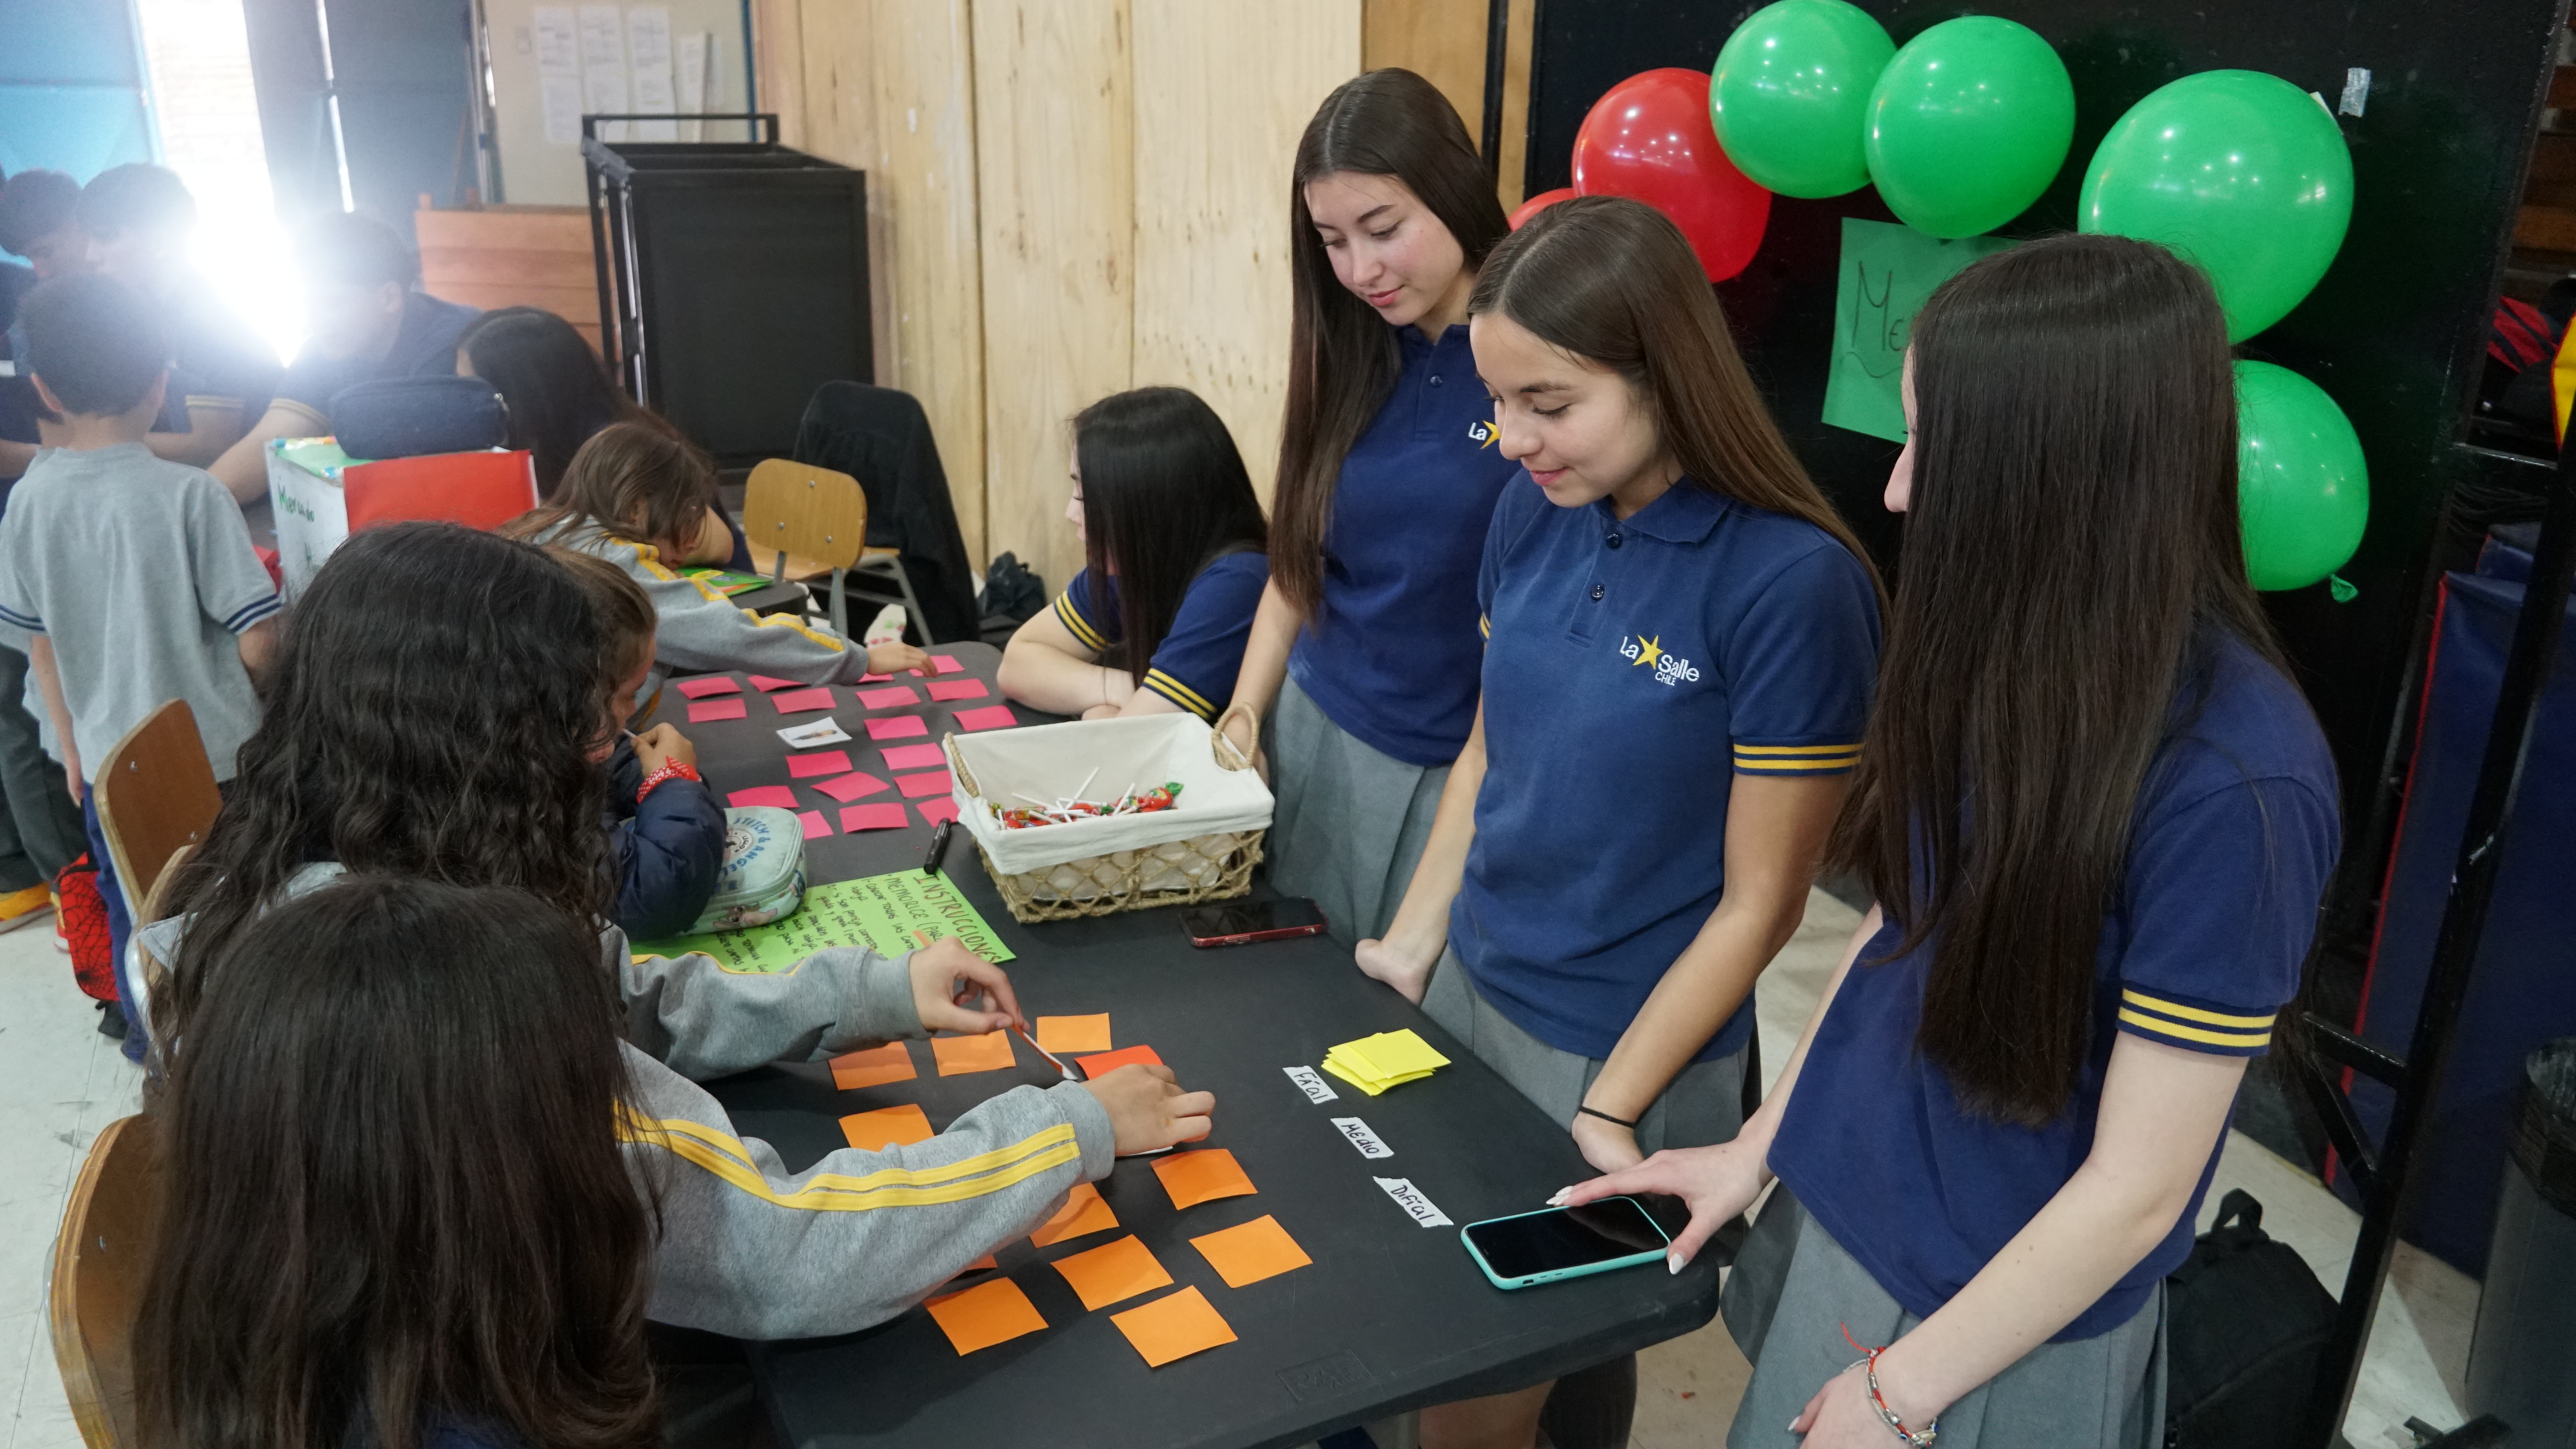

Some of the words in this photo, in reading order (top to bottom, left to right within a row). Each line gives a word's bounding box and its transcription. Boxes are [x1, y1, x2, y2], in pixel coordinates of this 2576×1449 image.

[1468, 422, 1487, 441] La
[1619, 636, 1639, 660] La
[1658, 654, 1700, 682] Salle
[1655, 671, 1677, 686] CHILE
[884, 877, 929, 919] MEMORICE
[913, 875, 1002, 963] INSTRUCCIONES
